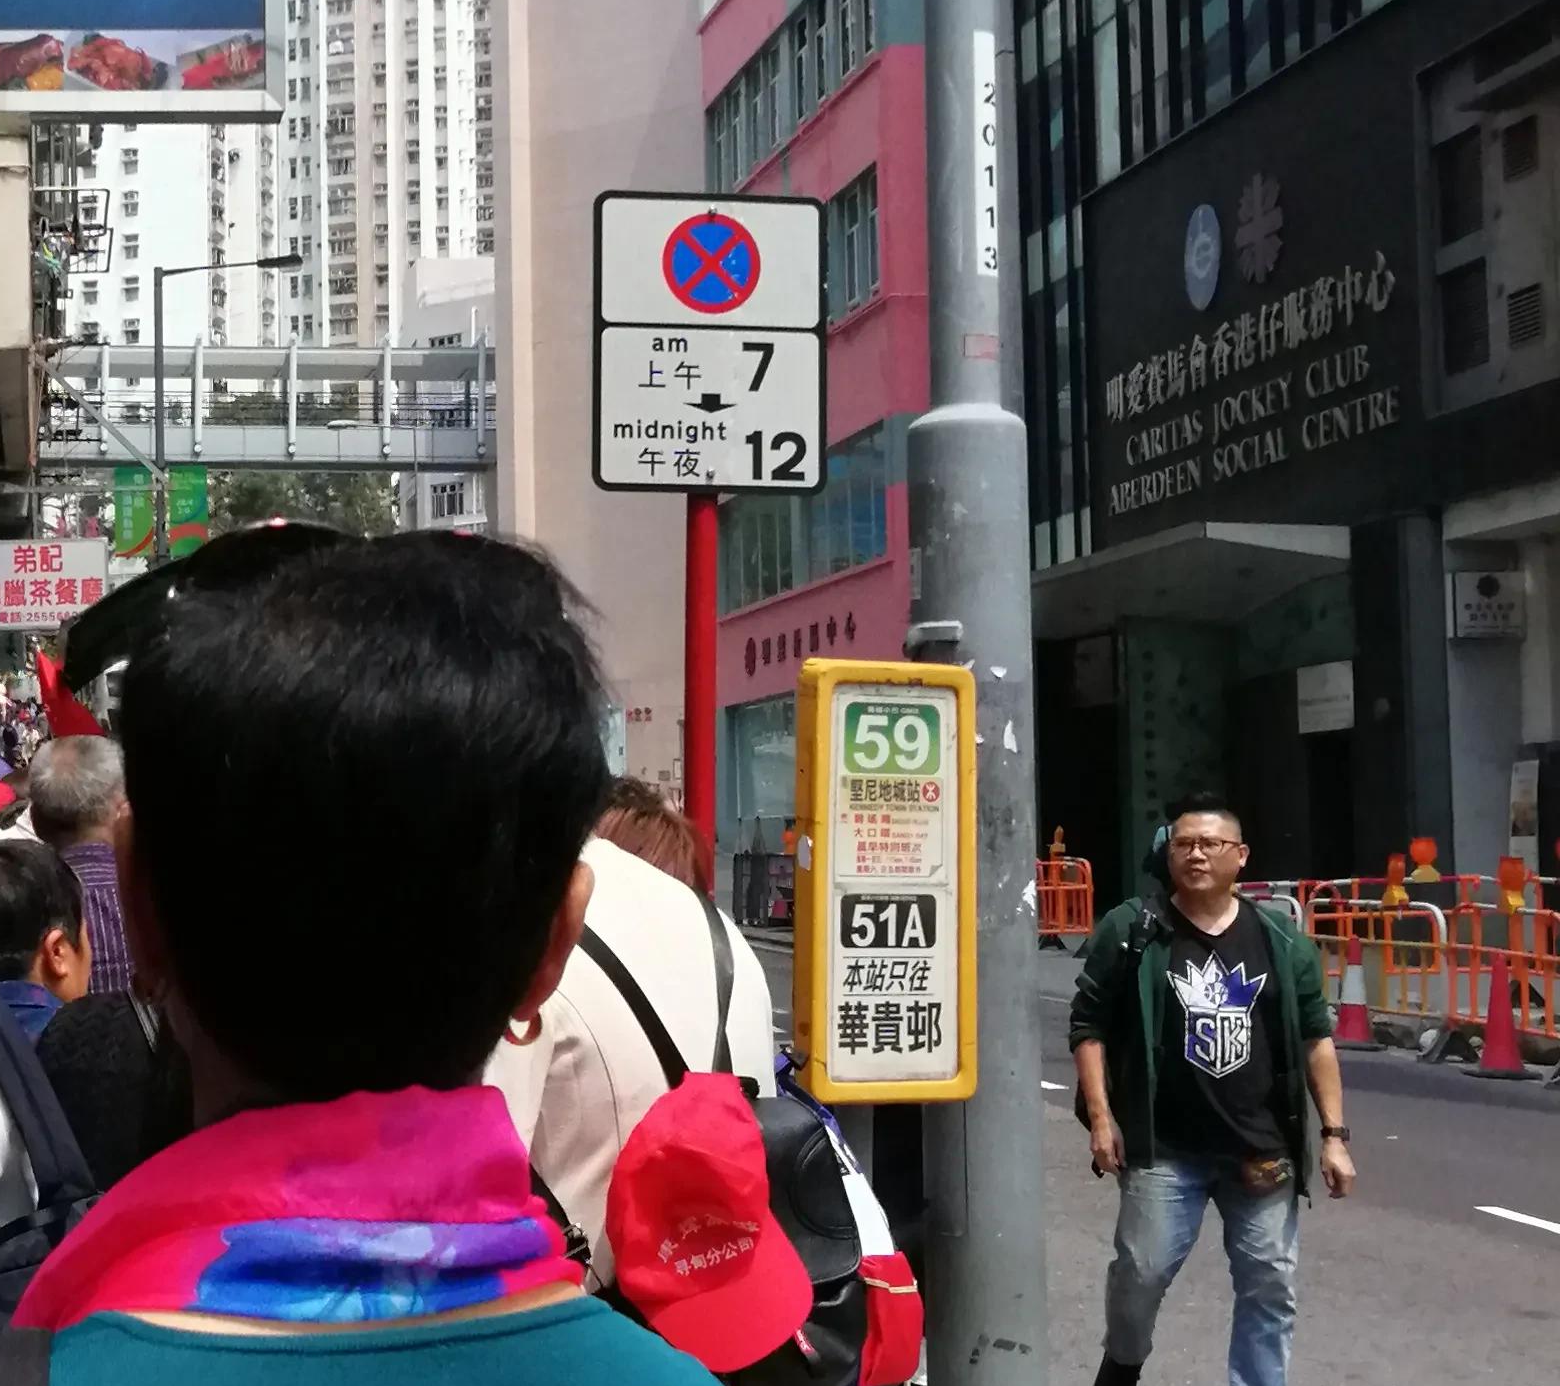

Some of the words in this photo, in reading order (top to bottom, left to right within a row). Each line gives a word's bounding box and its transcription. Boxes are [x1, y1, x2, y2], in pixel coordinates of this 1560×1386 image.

[651, 336, 688, 354] am
[1105, 250, 1396, 423] 明愛賽馬會香港仔服務中心
[638, 360, 703, 391] 上午
[742, 342, 775, 392] 7
[1126, 409, 1204, 467] CARITAS
[1211, 371, 1294, 445] JOCKEY
[1304, 344, 1371, 399] CLUB
[613, 420, 727, 445] midnight
[745, 430, 807, 482] 12
[1108, 456, 1203, 517] ABERDEEN
[1211, 426, 1289, 483] SOCIAL
[1301, 386, 1401, 451] CENTRE
[637, 448, 702, 478] 午夜
[13, 544, 63, 574] 弟記
[853, 714, 930, 771] 59
[850, 903, 927, 947] 51A
[842, 958, 932, 994] 本站只往
[837, 1000, 942, 1055] 華貴邨
